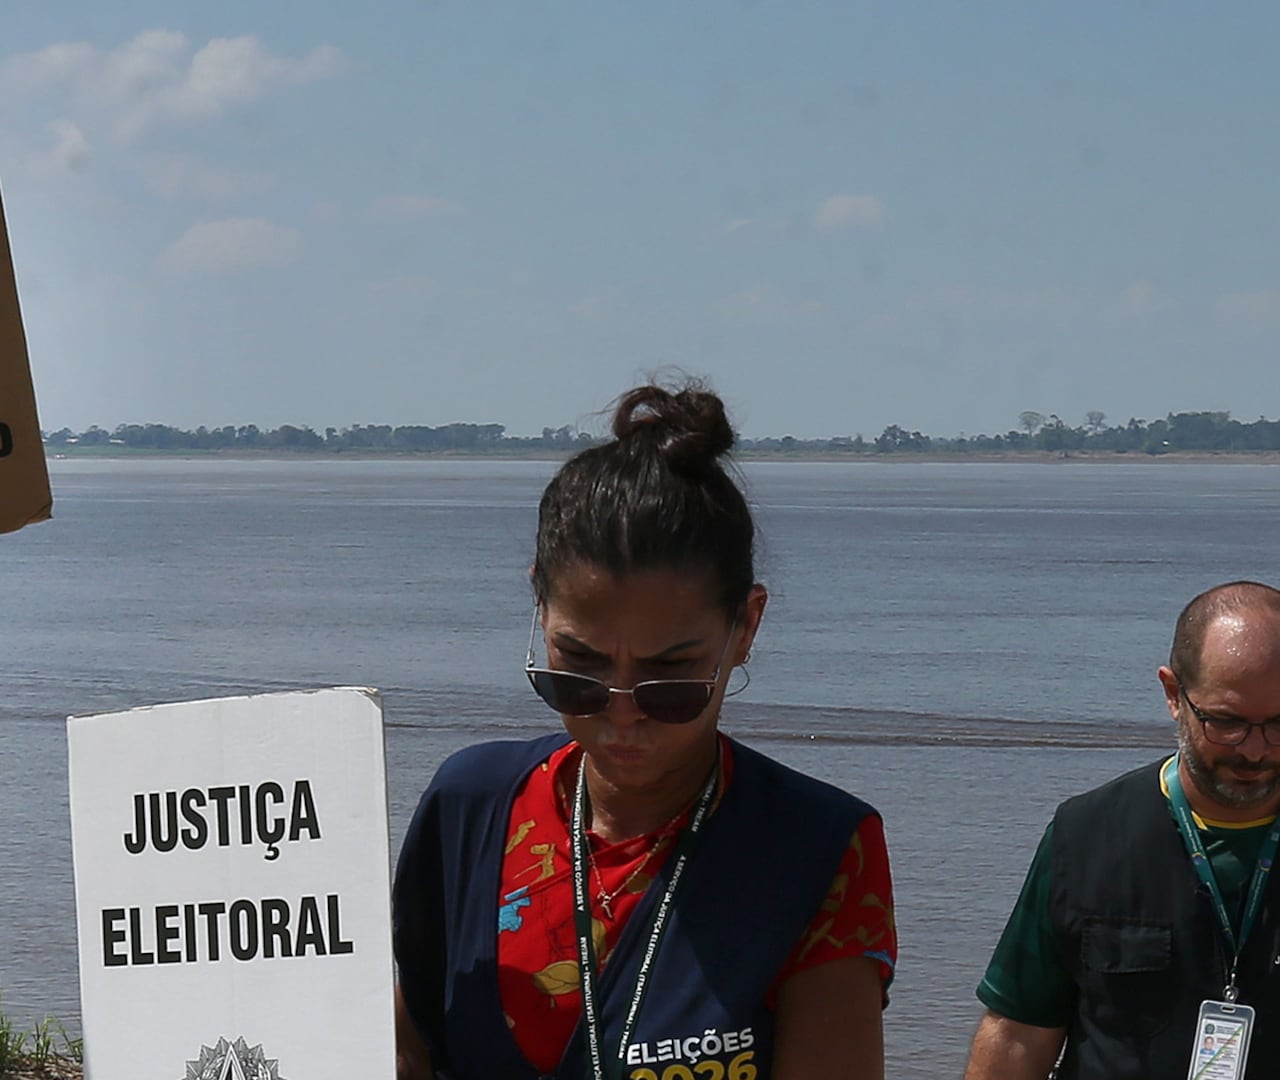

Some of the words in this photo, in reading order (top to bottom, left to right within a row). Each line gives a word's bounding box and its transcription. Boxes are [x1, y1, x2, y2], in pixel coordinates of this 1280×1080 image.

[123, 780, 322, 861] JUSTIÇA
[573, 830, 581, 859] JUSTIÇA
[574, 860, 582, 871] DA
[668, 861, 685, 892] SERVIÇO
[575, 871, 584, 904] SERVIÇO
[101, 894, 354, 967] ELEITORAL
[653, 903, 668, 933] JUSTIÇA
[639, 934, 659, 974] ELEITORAL
[589, 1025, 599, 1065] ELEITORAL
[626, 1027, 755, 1065] ELEIÇÕES
